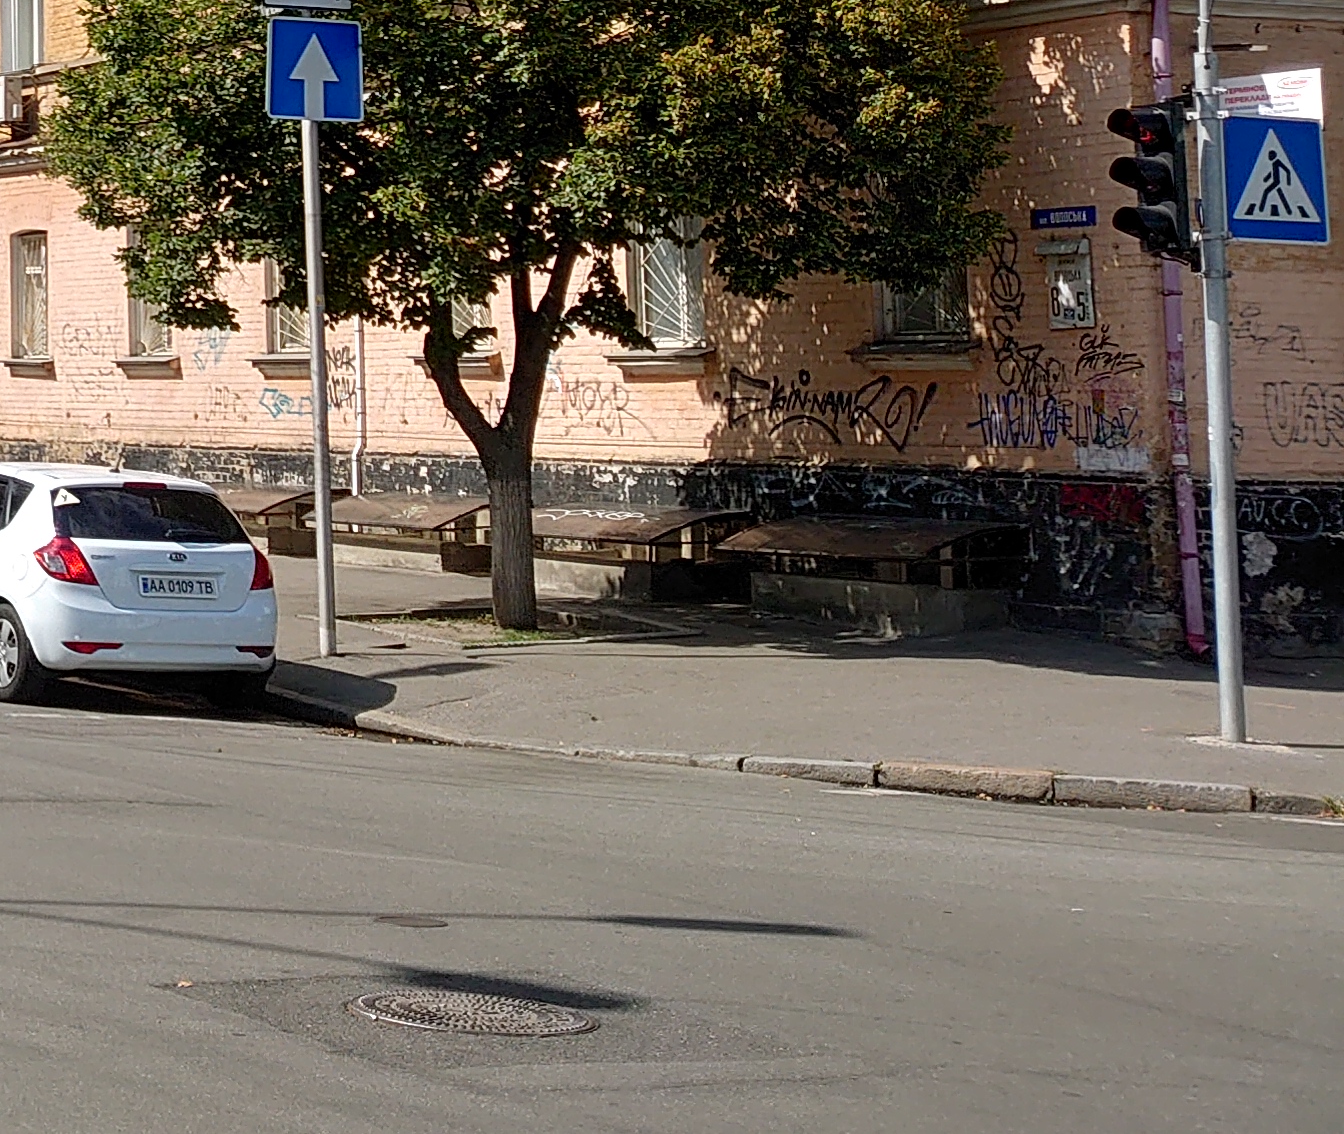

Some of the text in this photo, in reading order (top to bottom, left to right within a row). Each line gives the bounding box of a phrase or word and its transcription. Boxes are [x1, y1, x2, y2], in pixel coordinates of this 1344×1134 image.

[1051, 287, 1061, 317] 8
[1076, 291, 1086, 322] 5
[150, 579, 213, 594] AA 0109 TB
